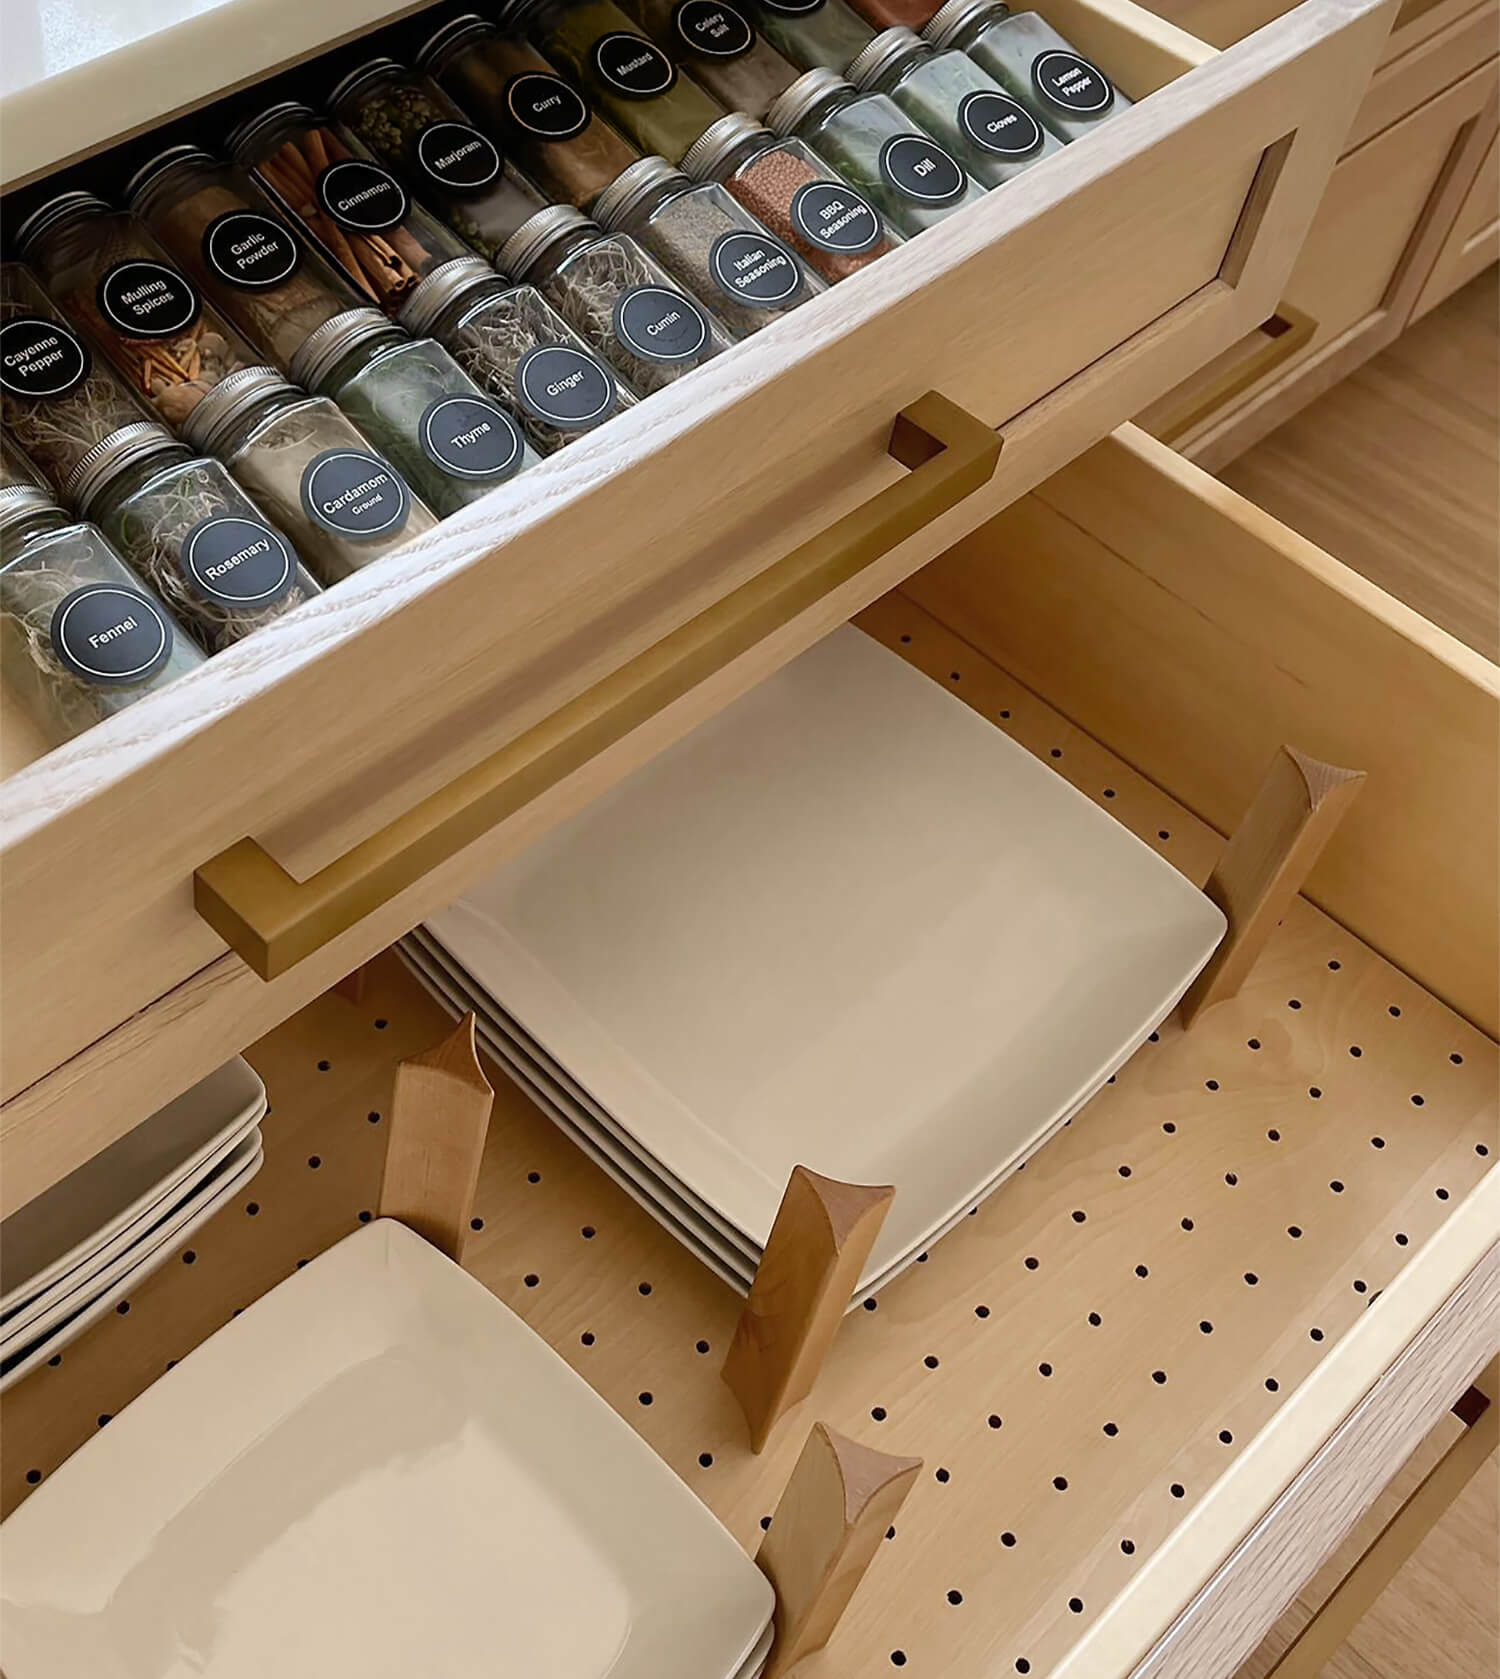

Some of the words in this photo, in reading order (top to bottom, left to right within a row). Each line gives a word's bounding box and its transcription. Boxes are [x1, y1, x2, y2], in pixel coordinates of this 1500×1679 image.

[616, 52, 654, 77] Mustard
[1051, 67, 1083, 88] Lemon
[1061, 76, 1093, 98] Pepper
[532, 94, 562, 114] Curry
[986, 113, 1018, 134] Cloves
[434, 139, 483, 170] Marjoram
[913, 157, 937, 177] Dill
[337, 181, 392, 212] Cinnamon
[818, 200, 845, 221] BBQ
[819, 203, 868, 240] Seasoning
[230, 232, 265, 256] Garlic
[236, 241, 280, 271] Powder
[732, 248, 766, 272] Italian
[734, 253, 787, 289] Seasoning
[120, 279, 168, 306] Mulling
[132, 291, 175, 317] Spices
[646, 310, 681, 337] Cumin
[4, 335, 59, 369] Cayenne
[18, 349, 64, 378] Pepper
[545, 369, 586, 399] Ginger
[450, 421, 492, 451] Thyme
[322, 473, 389, 514] Cardamom
[351, 493, 384, 515] Ground
[204, 538, 271, 581] Rosemary
[88, 616, 139, 649] Fennel
